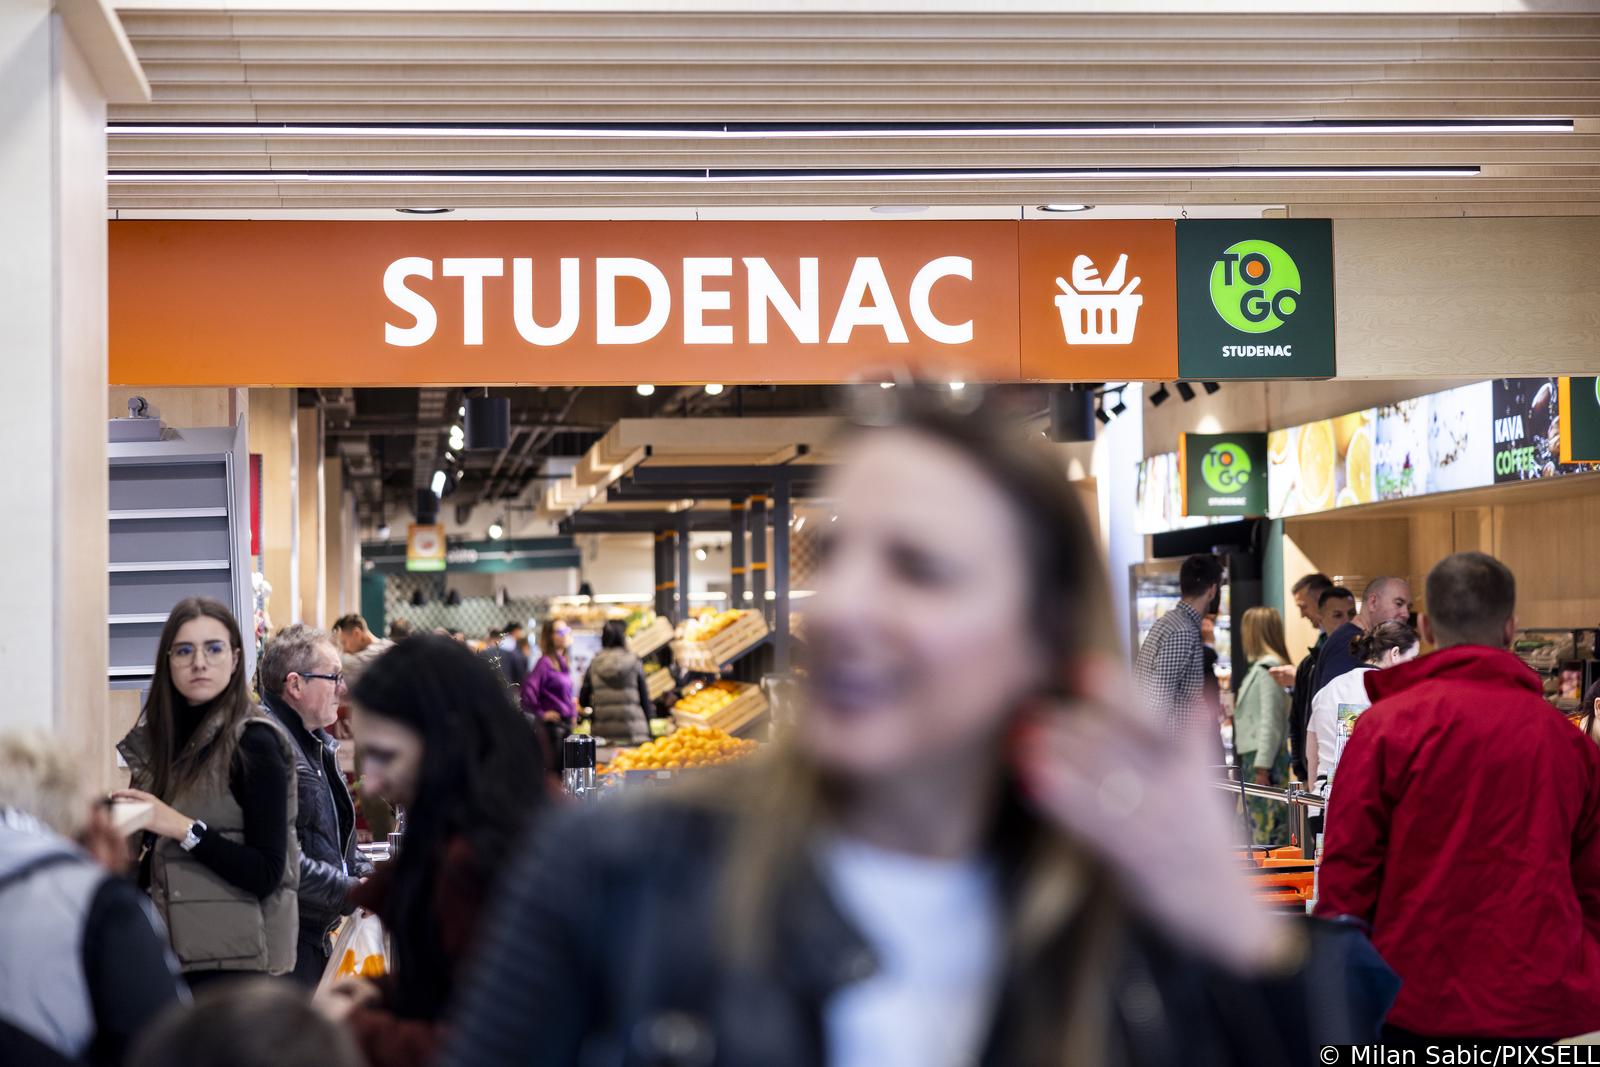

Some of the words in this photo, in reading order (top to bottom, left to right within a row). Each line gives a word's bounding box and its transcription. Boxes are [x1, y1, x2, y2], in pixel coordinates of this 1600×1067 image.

[1217, 253, 1271, 286] TO
[382, 256, 975, 347] STUDENAC
[1240, 289, 1303, 322] GO
[1222, 345, 1292, 358] STUDENAC
[1494, 415, 1524, 443] KAVA
[1206, 451, 1234, 467] TO
[1496, 446, 1535, 475] COFFEE
[1220, 470, 1251, 485] GO
